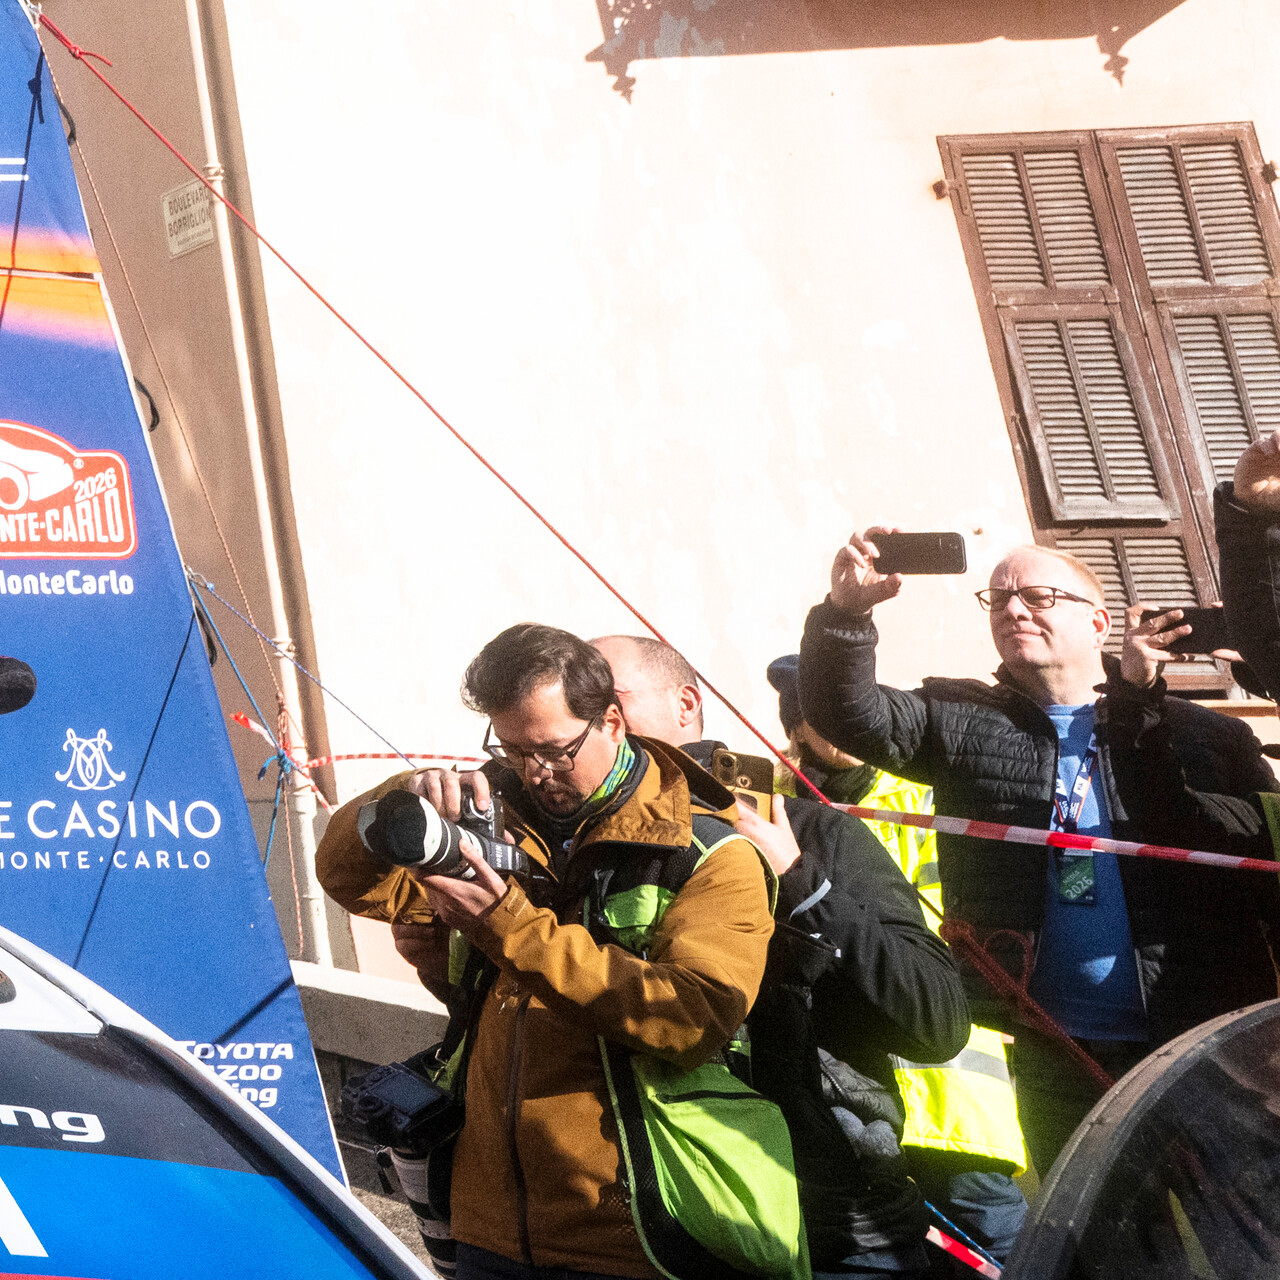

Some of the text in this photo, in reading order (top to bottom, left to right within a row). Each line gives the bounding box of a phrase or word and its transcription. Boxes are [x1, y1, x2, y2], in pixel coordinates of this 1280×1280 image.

[73, 467, 118, 503] 2026
[27, 799, 223, 840] CASINO
[1064, 876, 1094, 901] 2026
[208, 1064, 282, 1081] ZOO
